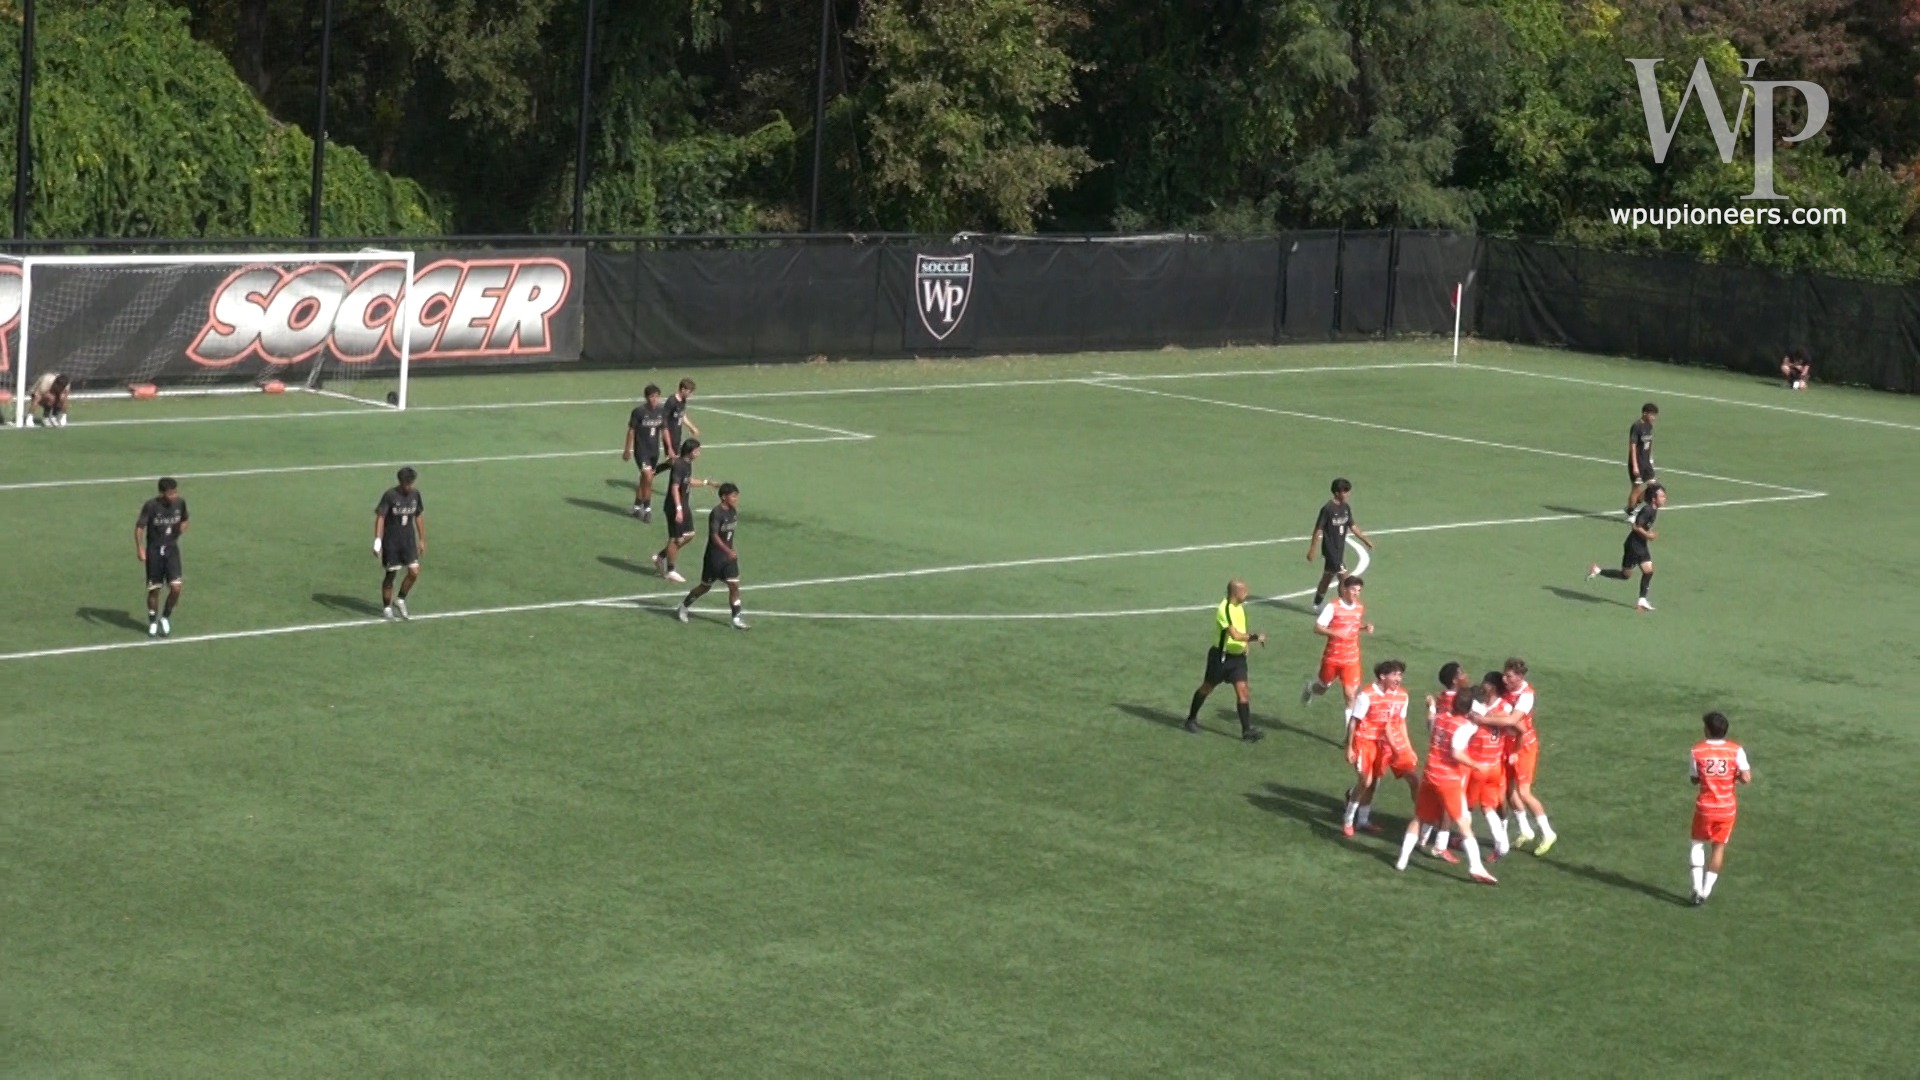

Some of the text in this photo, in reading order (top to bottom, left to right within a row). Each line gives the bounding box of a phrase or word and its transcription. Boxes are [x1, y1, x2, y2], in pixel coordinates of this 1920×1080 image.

[921, 261, 969, 273] SOCCER
[186, 258, 572, 367] SOCCER
[922, 279, 964, 322] WP
[1705, 758, 1727, 775] 23
